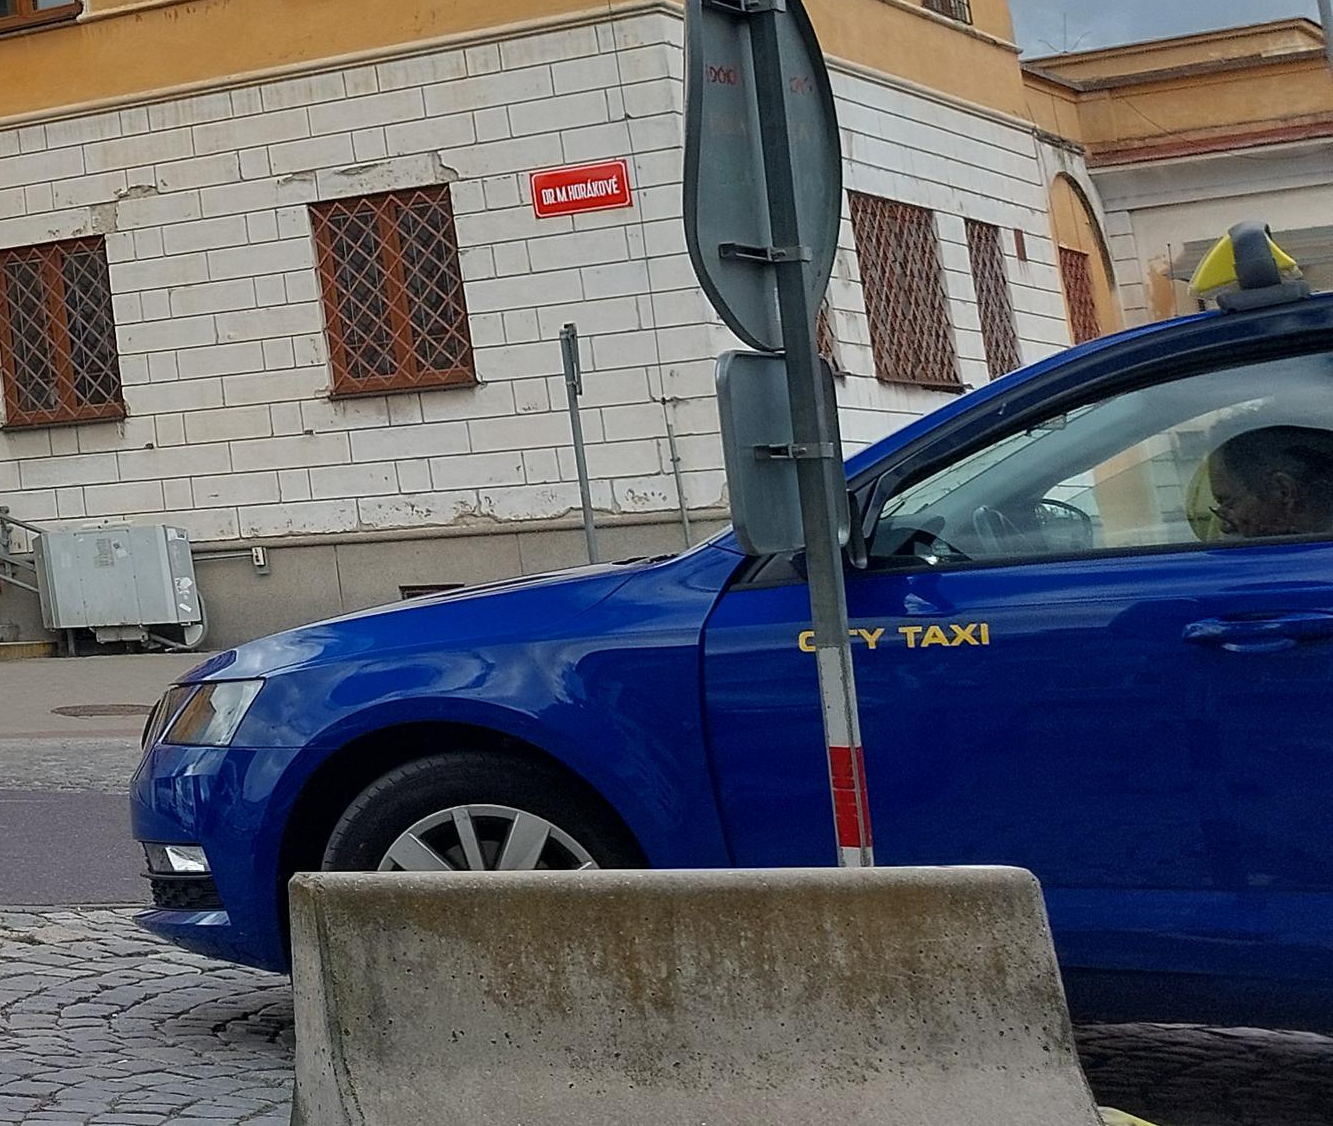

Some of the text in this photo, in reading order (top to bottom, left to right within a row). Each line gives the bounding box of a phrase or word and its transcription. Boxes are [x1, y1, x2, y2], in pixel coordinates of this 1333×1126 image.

[568, 175, 620, 200] HORÁKOVÉ
[798, 622, 991, 653] CY TAXI
